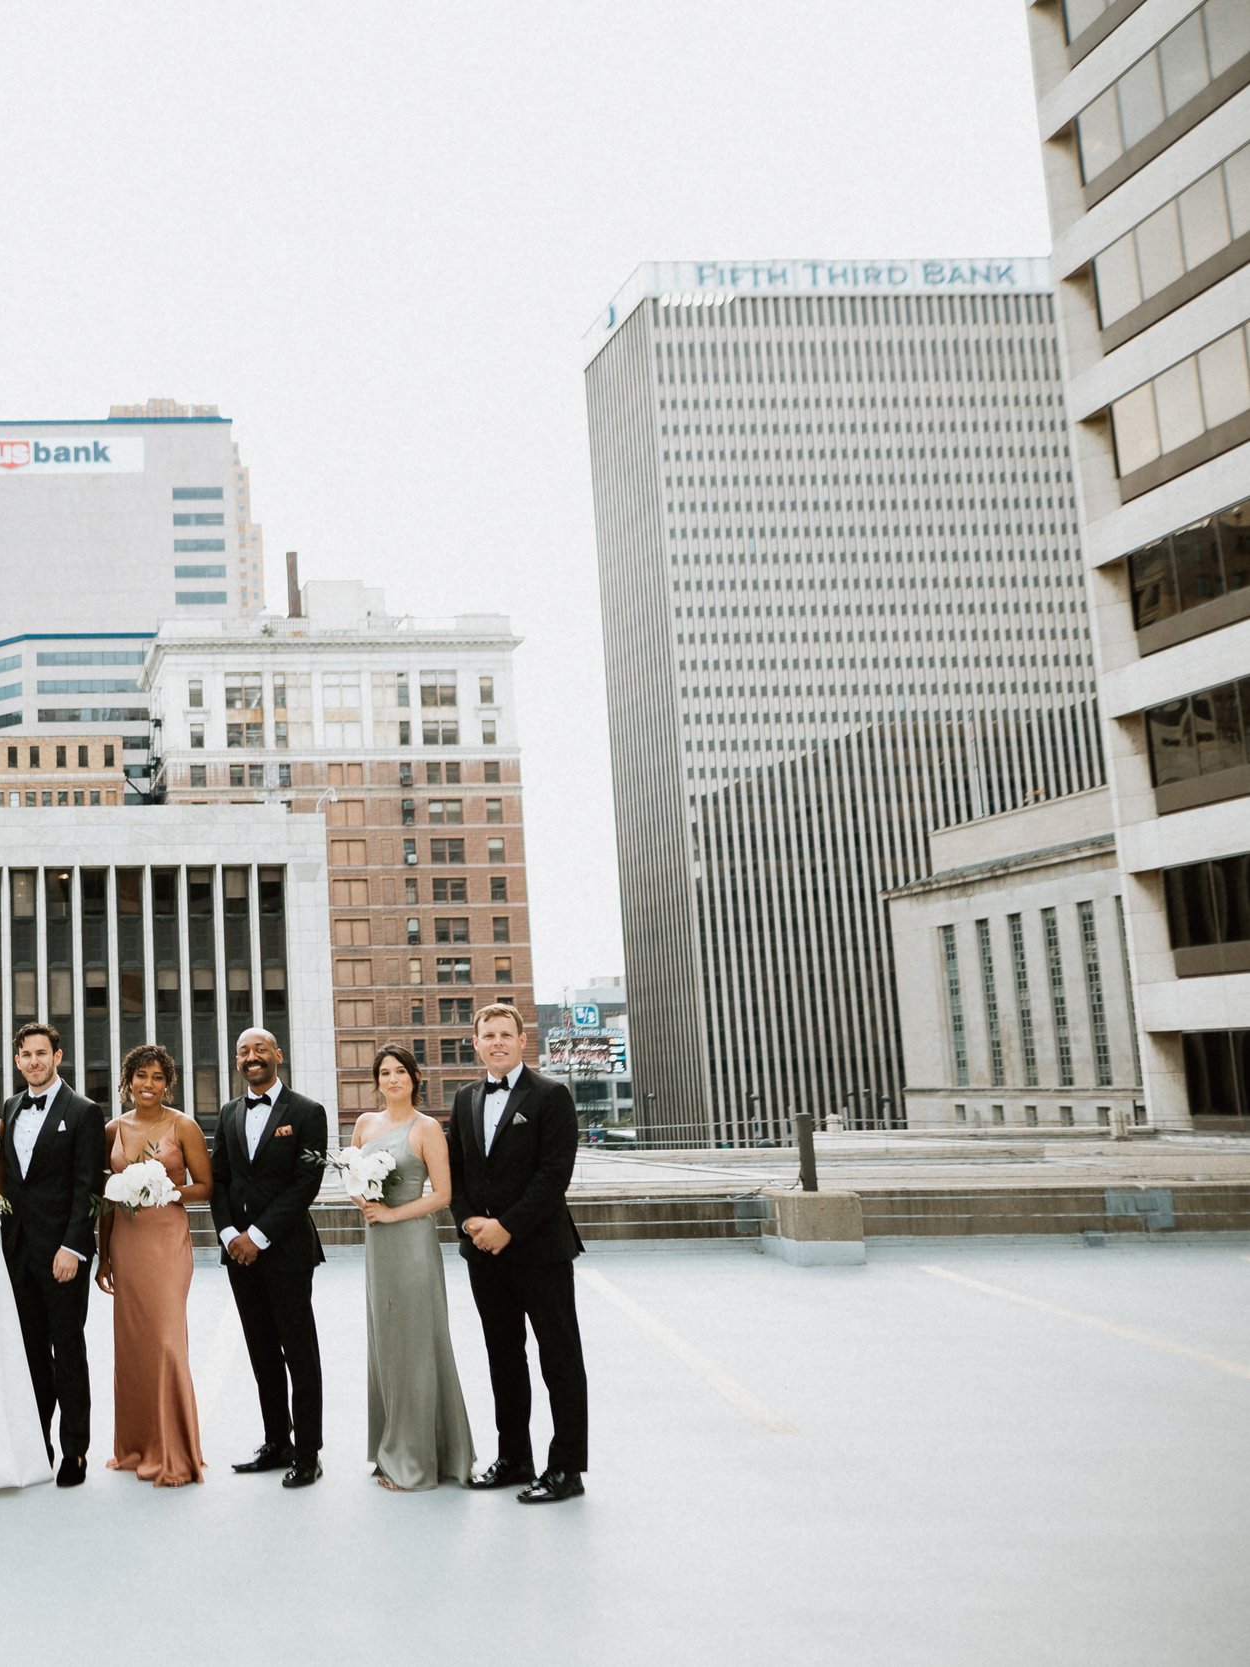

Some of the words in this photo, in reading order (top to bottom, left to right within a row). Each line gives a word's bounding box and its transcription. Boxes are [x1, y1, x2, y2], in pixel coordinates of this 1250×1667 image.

[697, 264, 787, 287] FIFTH
[802, 262, 907, 287] THIRD
[922, 262, 1016, 286] BANK
